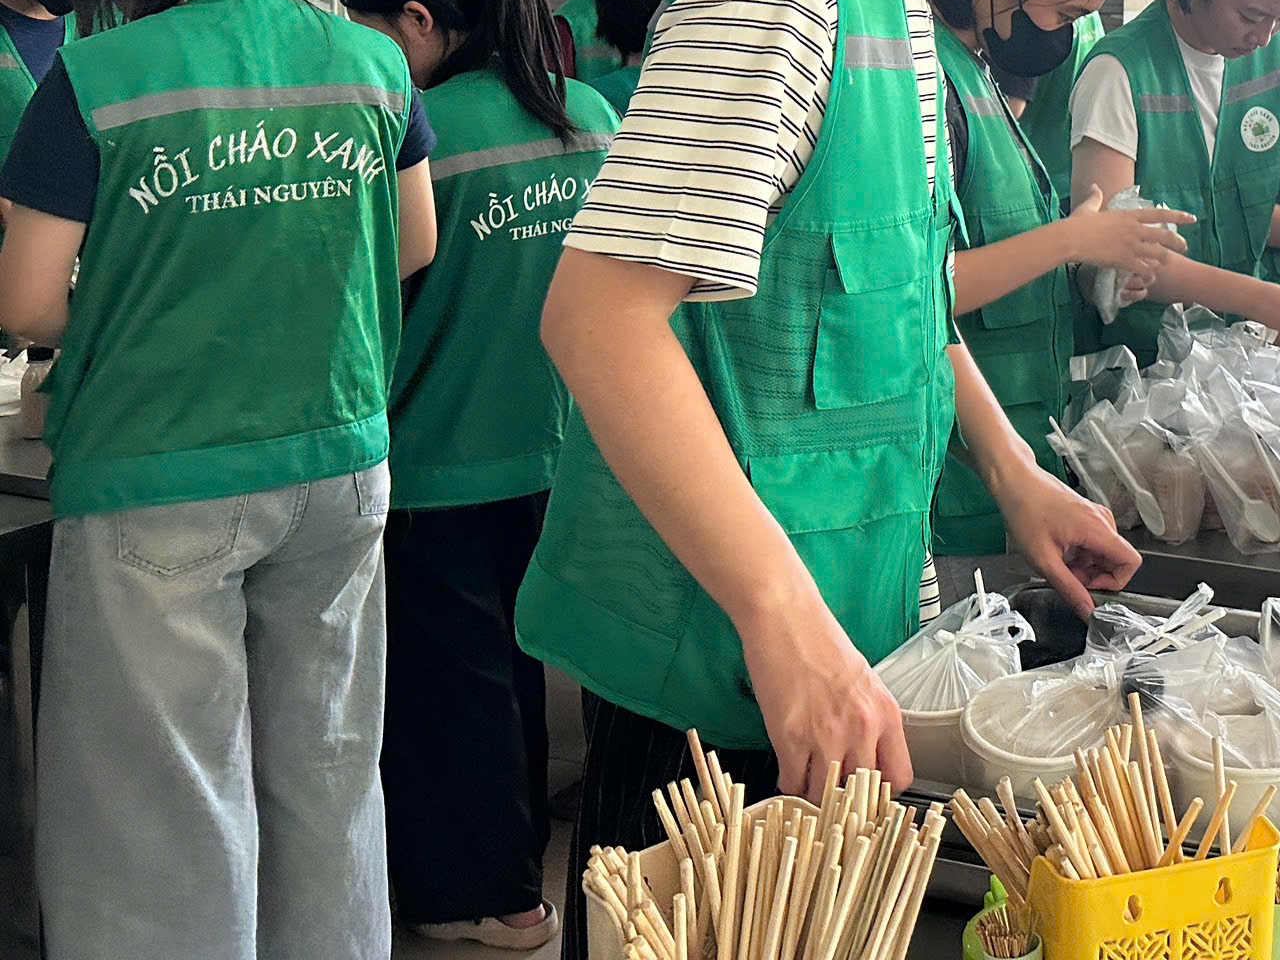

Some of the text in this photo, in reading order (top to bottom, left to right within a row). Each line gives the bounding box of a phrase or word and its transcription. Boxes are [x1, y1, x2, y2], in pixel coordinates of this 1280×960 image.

[128, 120, 387, 214] NỒI CHÁO XANH
[185, 176, 353, 215] THÁI NGUYÊN
[470, 192, 519, 240] NỒI
[523, 173, 577, 211] CHÁO
[509, 220, 547, 240] THÁI
